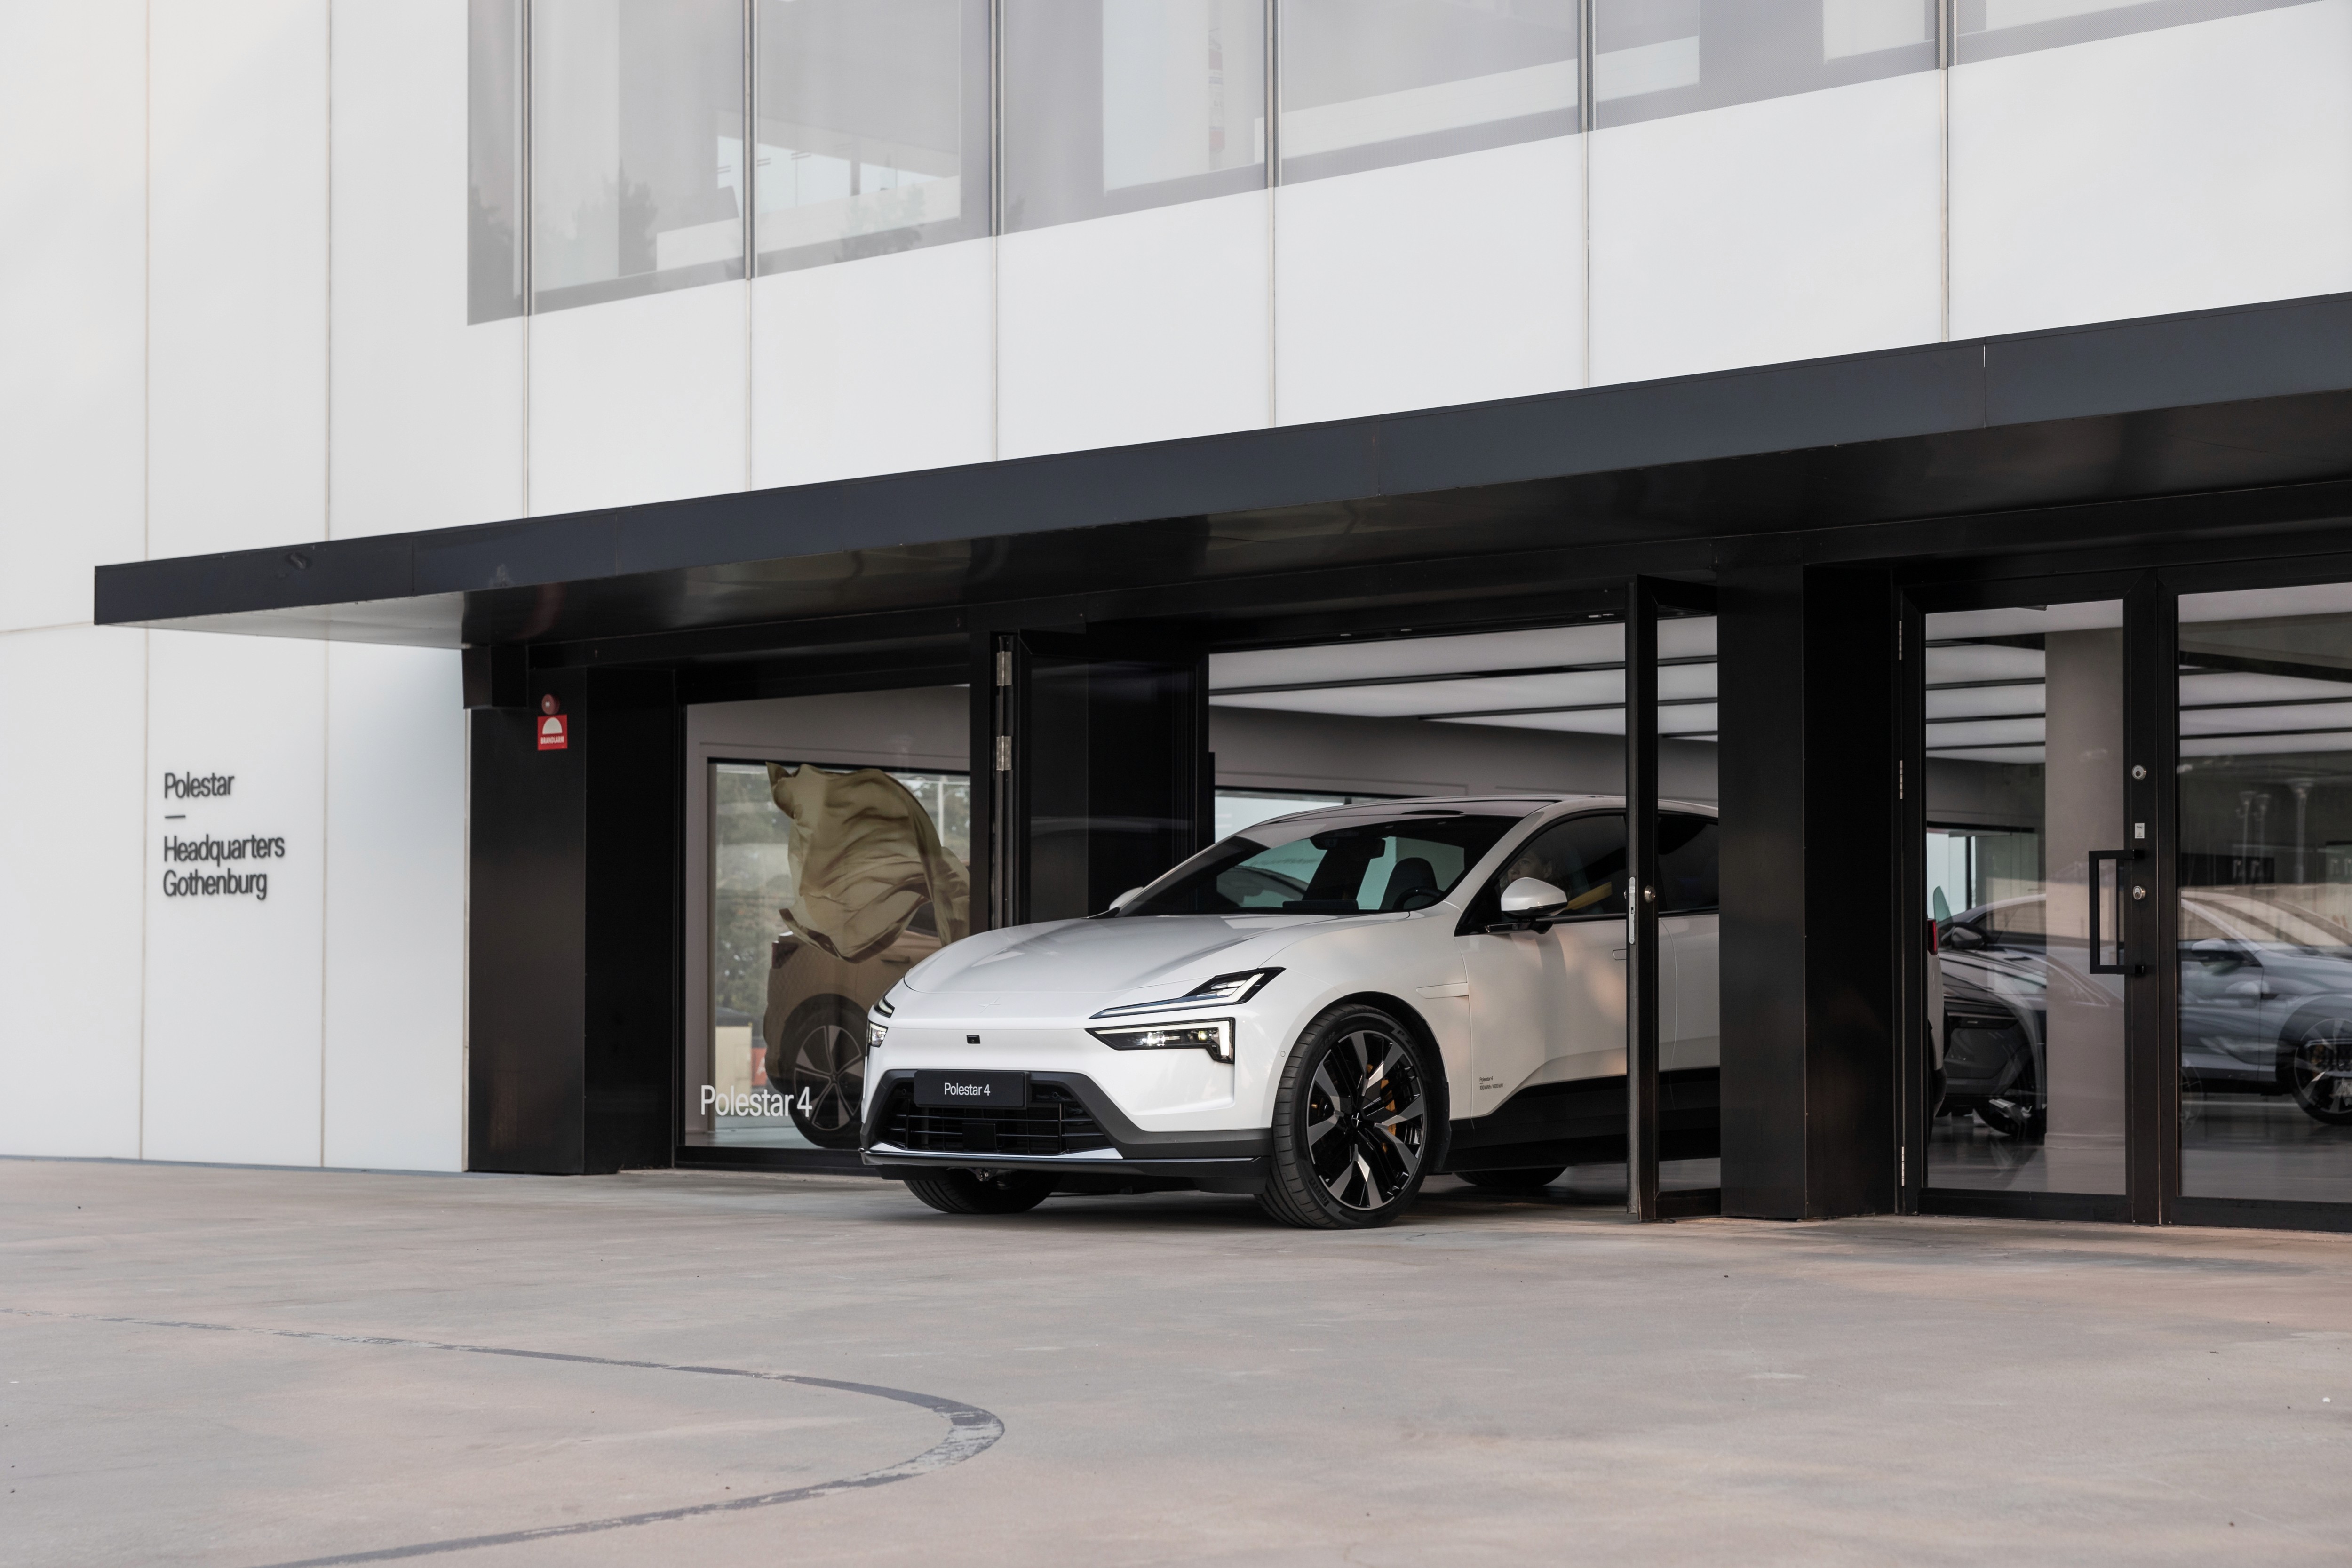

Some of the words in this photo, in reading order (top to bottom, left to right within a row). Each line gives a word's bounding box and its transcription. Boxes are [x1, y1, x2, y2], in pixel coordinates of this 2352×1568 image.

[164, 772, 235, 799] Polestar
[164, 834, 285, 867] Headquarters
[163, 868, 267, 901] Gothenburg
[701, 1085, 794, 1117] Polestar
[797, 1086, 813, 1117] 4
[944, 1082, 982, 1096] Polestar
[984, 1084, 991, 1096] 4
